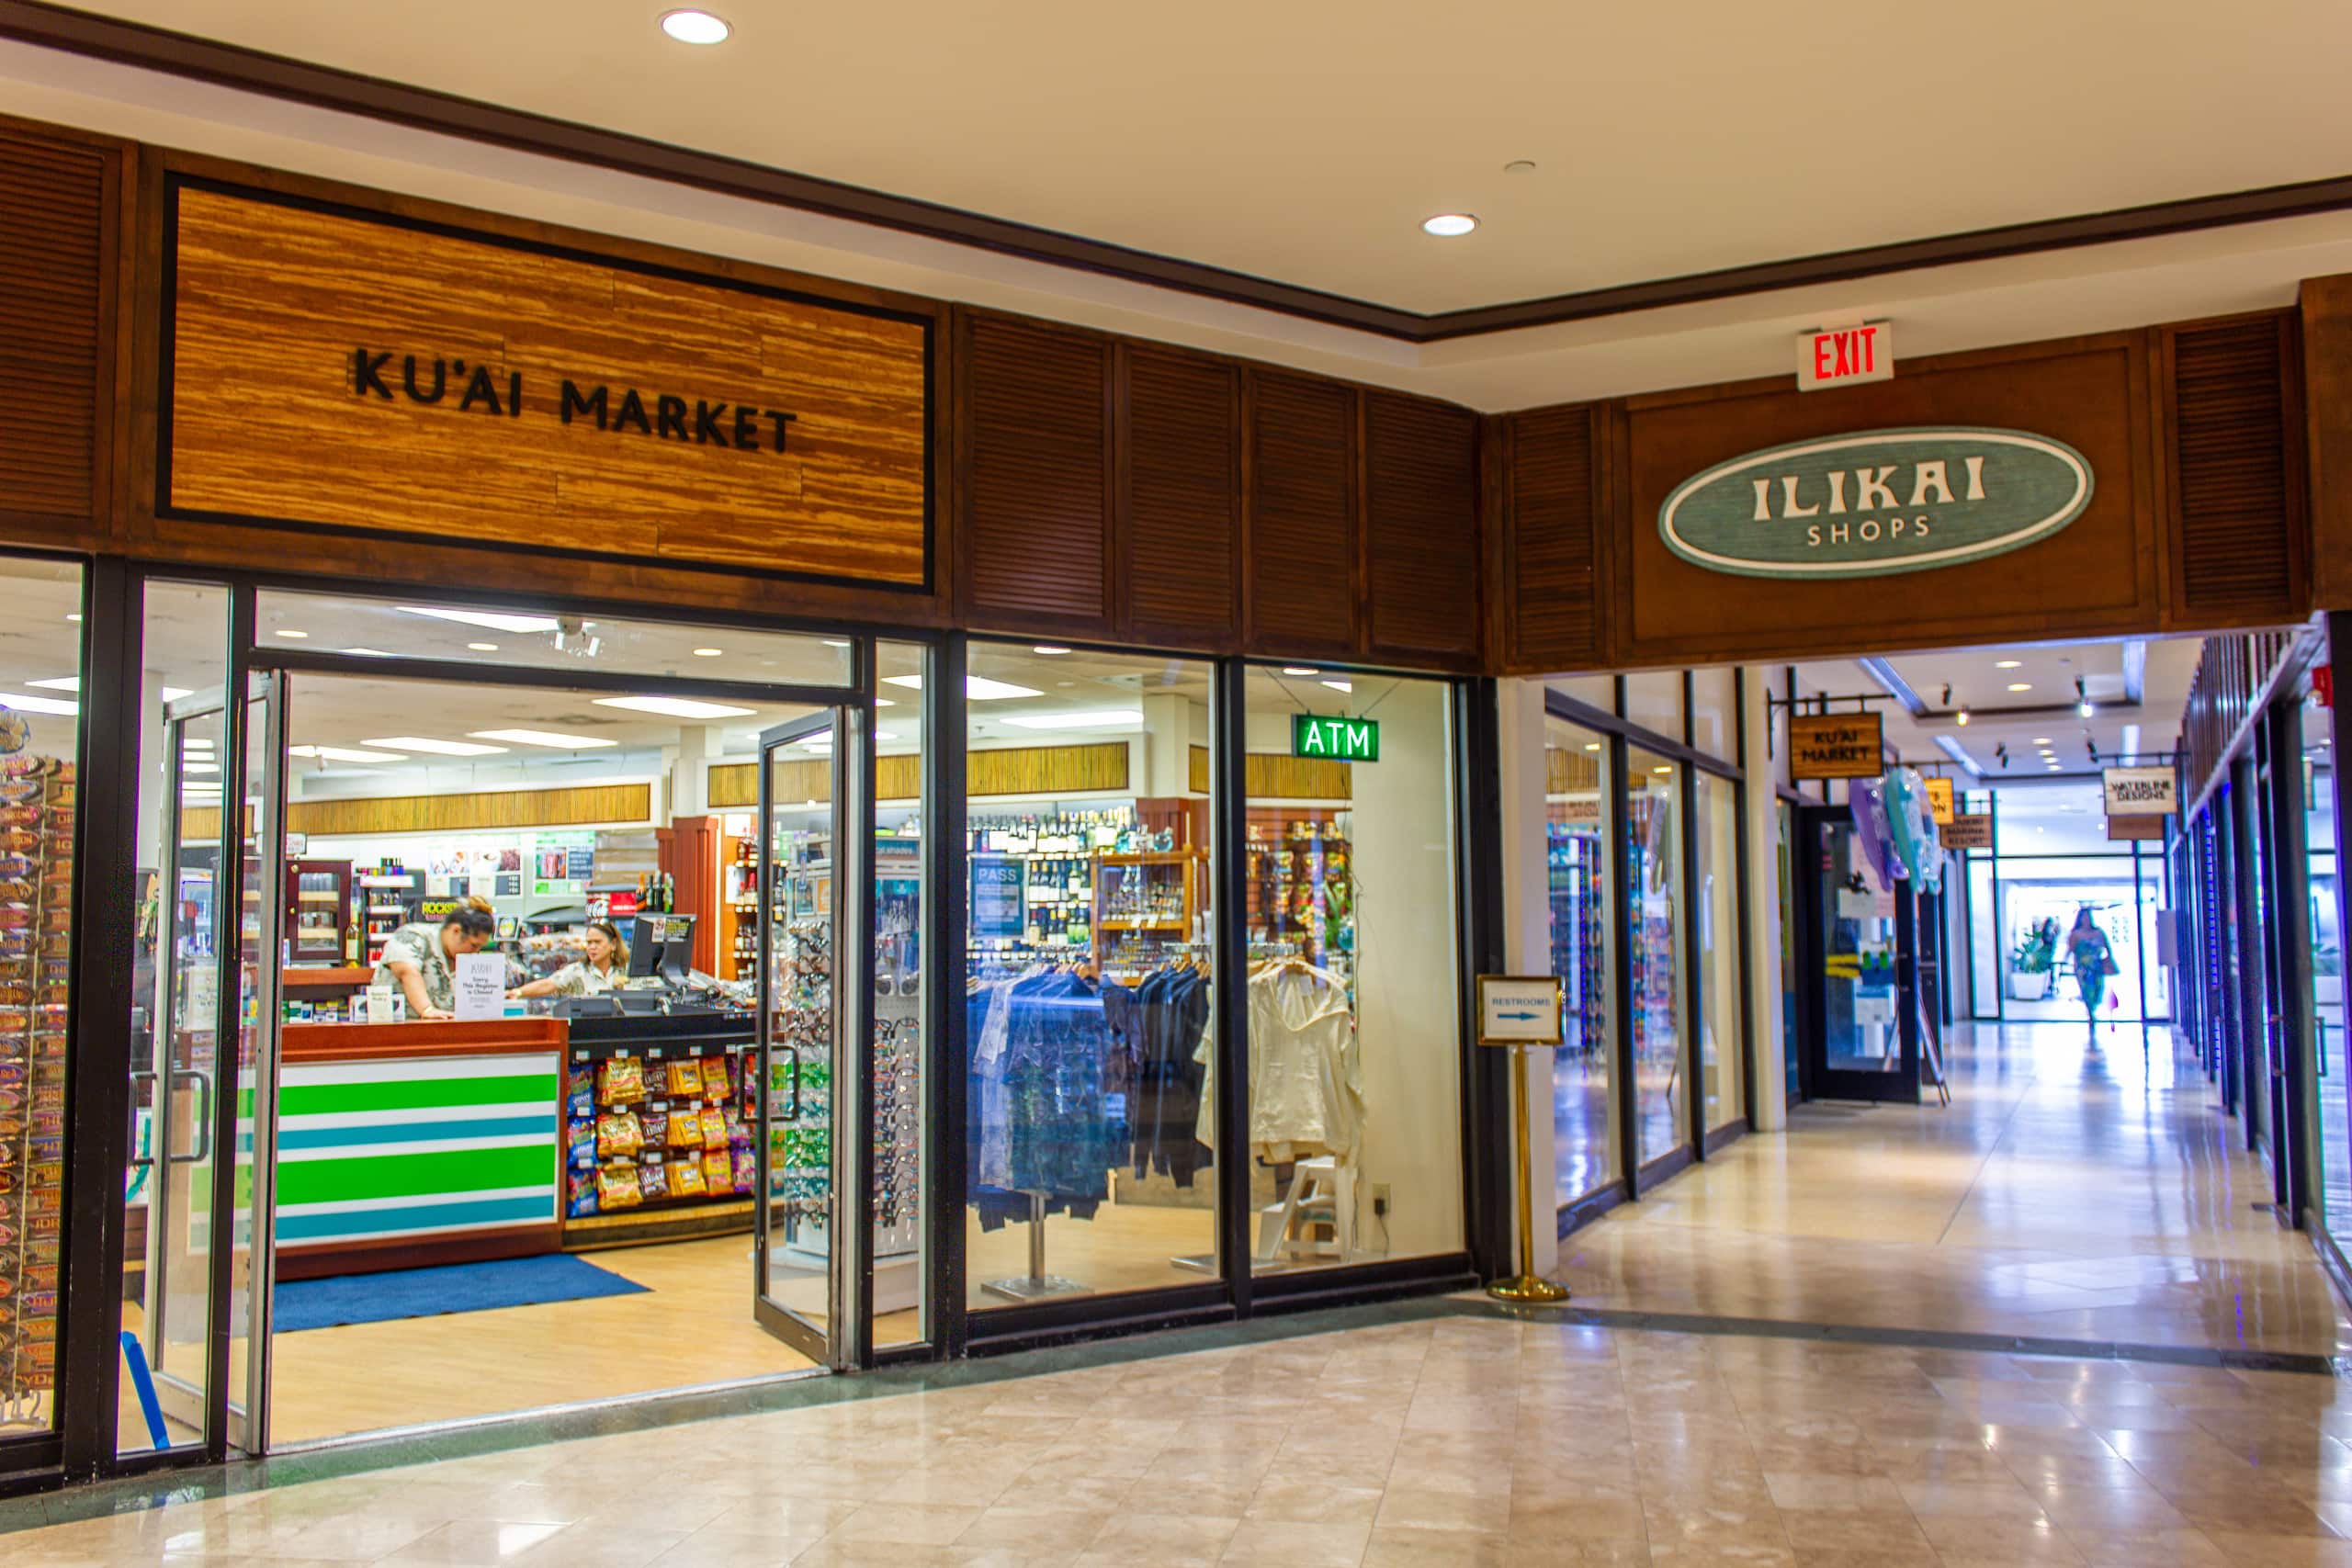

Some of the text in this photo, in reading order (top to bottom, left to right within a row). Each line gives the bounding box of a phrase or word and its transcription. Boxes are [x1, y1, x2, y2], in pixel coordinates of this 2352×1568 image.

[1814, 327, 1878, 380] EXIT
[353, 347, 797, 454] KU'AI MARKET
[1752, 456, 1986, 522] ILIKAI
[1807, 515, 1930, 547] SHOPS
[1304, 720, 1370, 757] ATM
[1802, 745, 1870, 762] MARKET
[2110, 780, 2171, 791] WATERLINE
[2117, 790, 2166, 802] DESIGNS
[978, 868, 1017, 882] PASS
[1491, 998, 1552, 1008] RESTROOMS
